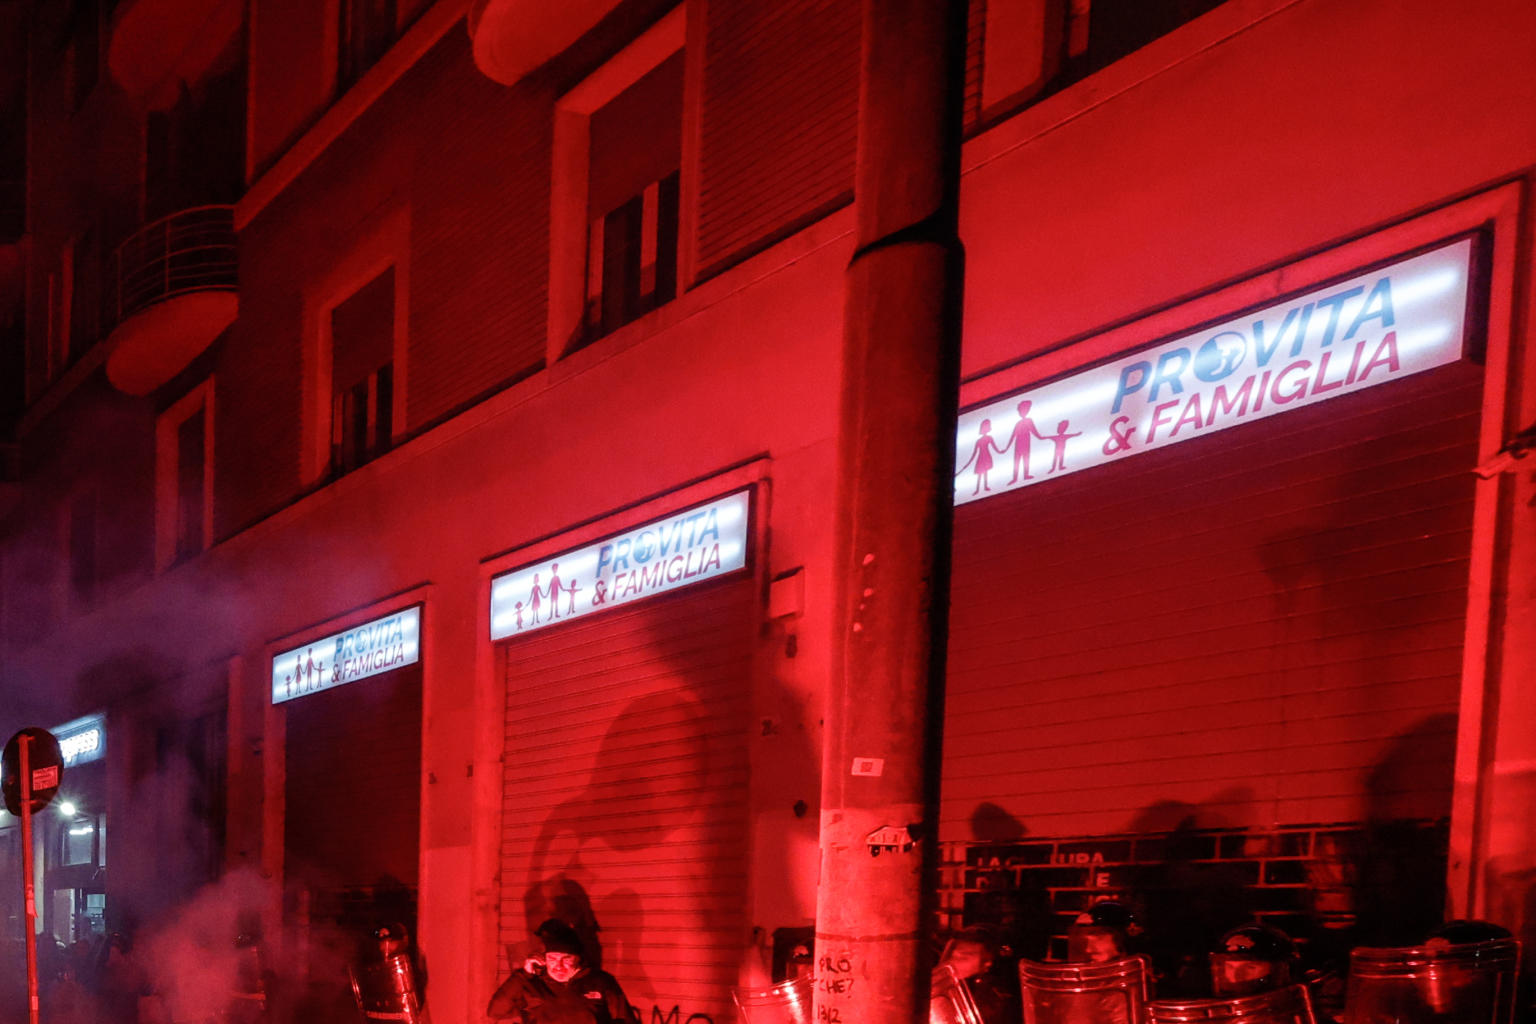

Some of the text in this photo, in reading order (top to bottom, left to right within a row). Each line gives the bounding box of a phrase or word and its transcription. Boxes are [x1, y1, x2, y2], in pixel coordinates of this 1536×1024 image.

[1110, 276, 1395, 415] PROVITA
[1102, 330, 1401, 455] & FAMIGLIA
[595, 507, 719, 578] PROVITA
[591, 543, 721, 606] & FAMIGLIA
[331, 643, 405, 684] & FAMIGLIA
[333, 616, 403, 662] PROVITA
[819, 957, 852, 974] PRO
